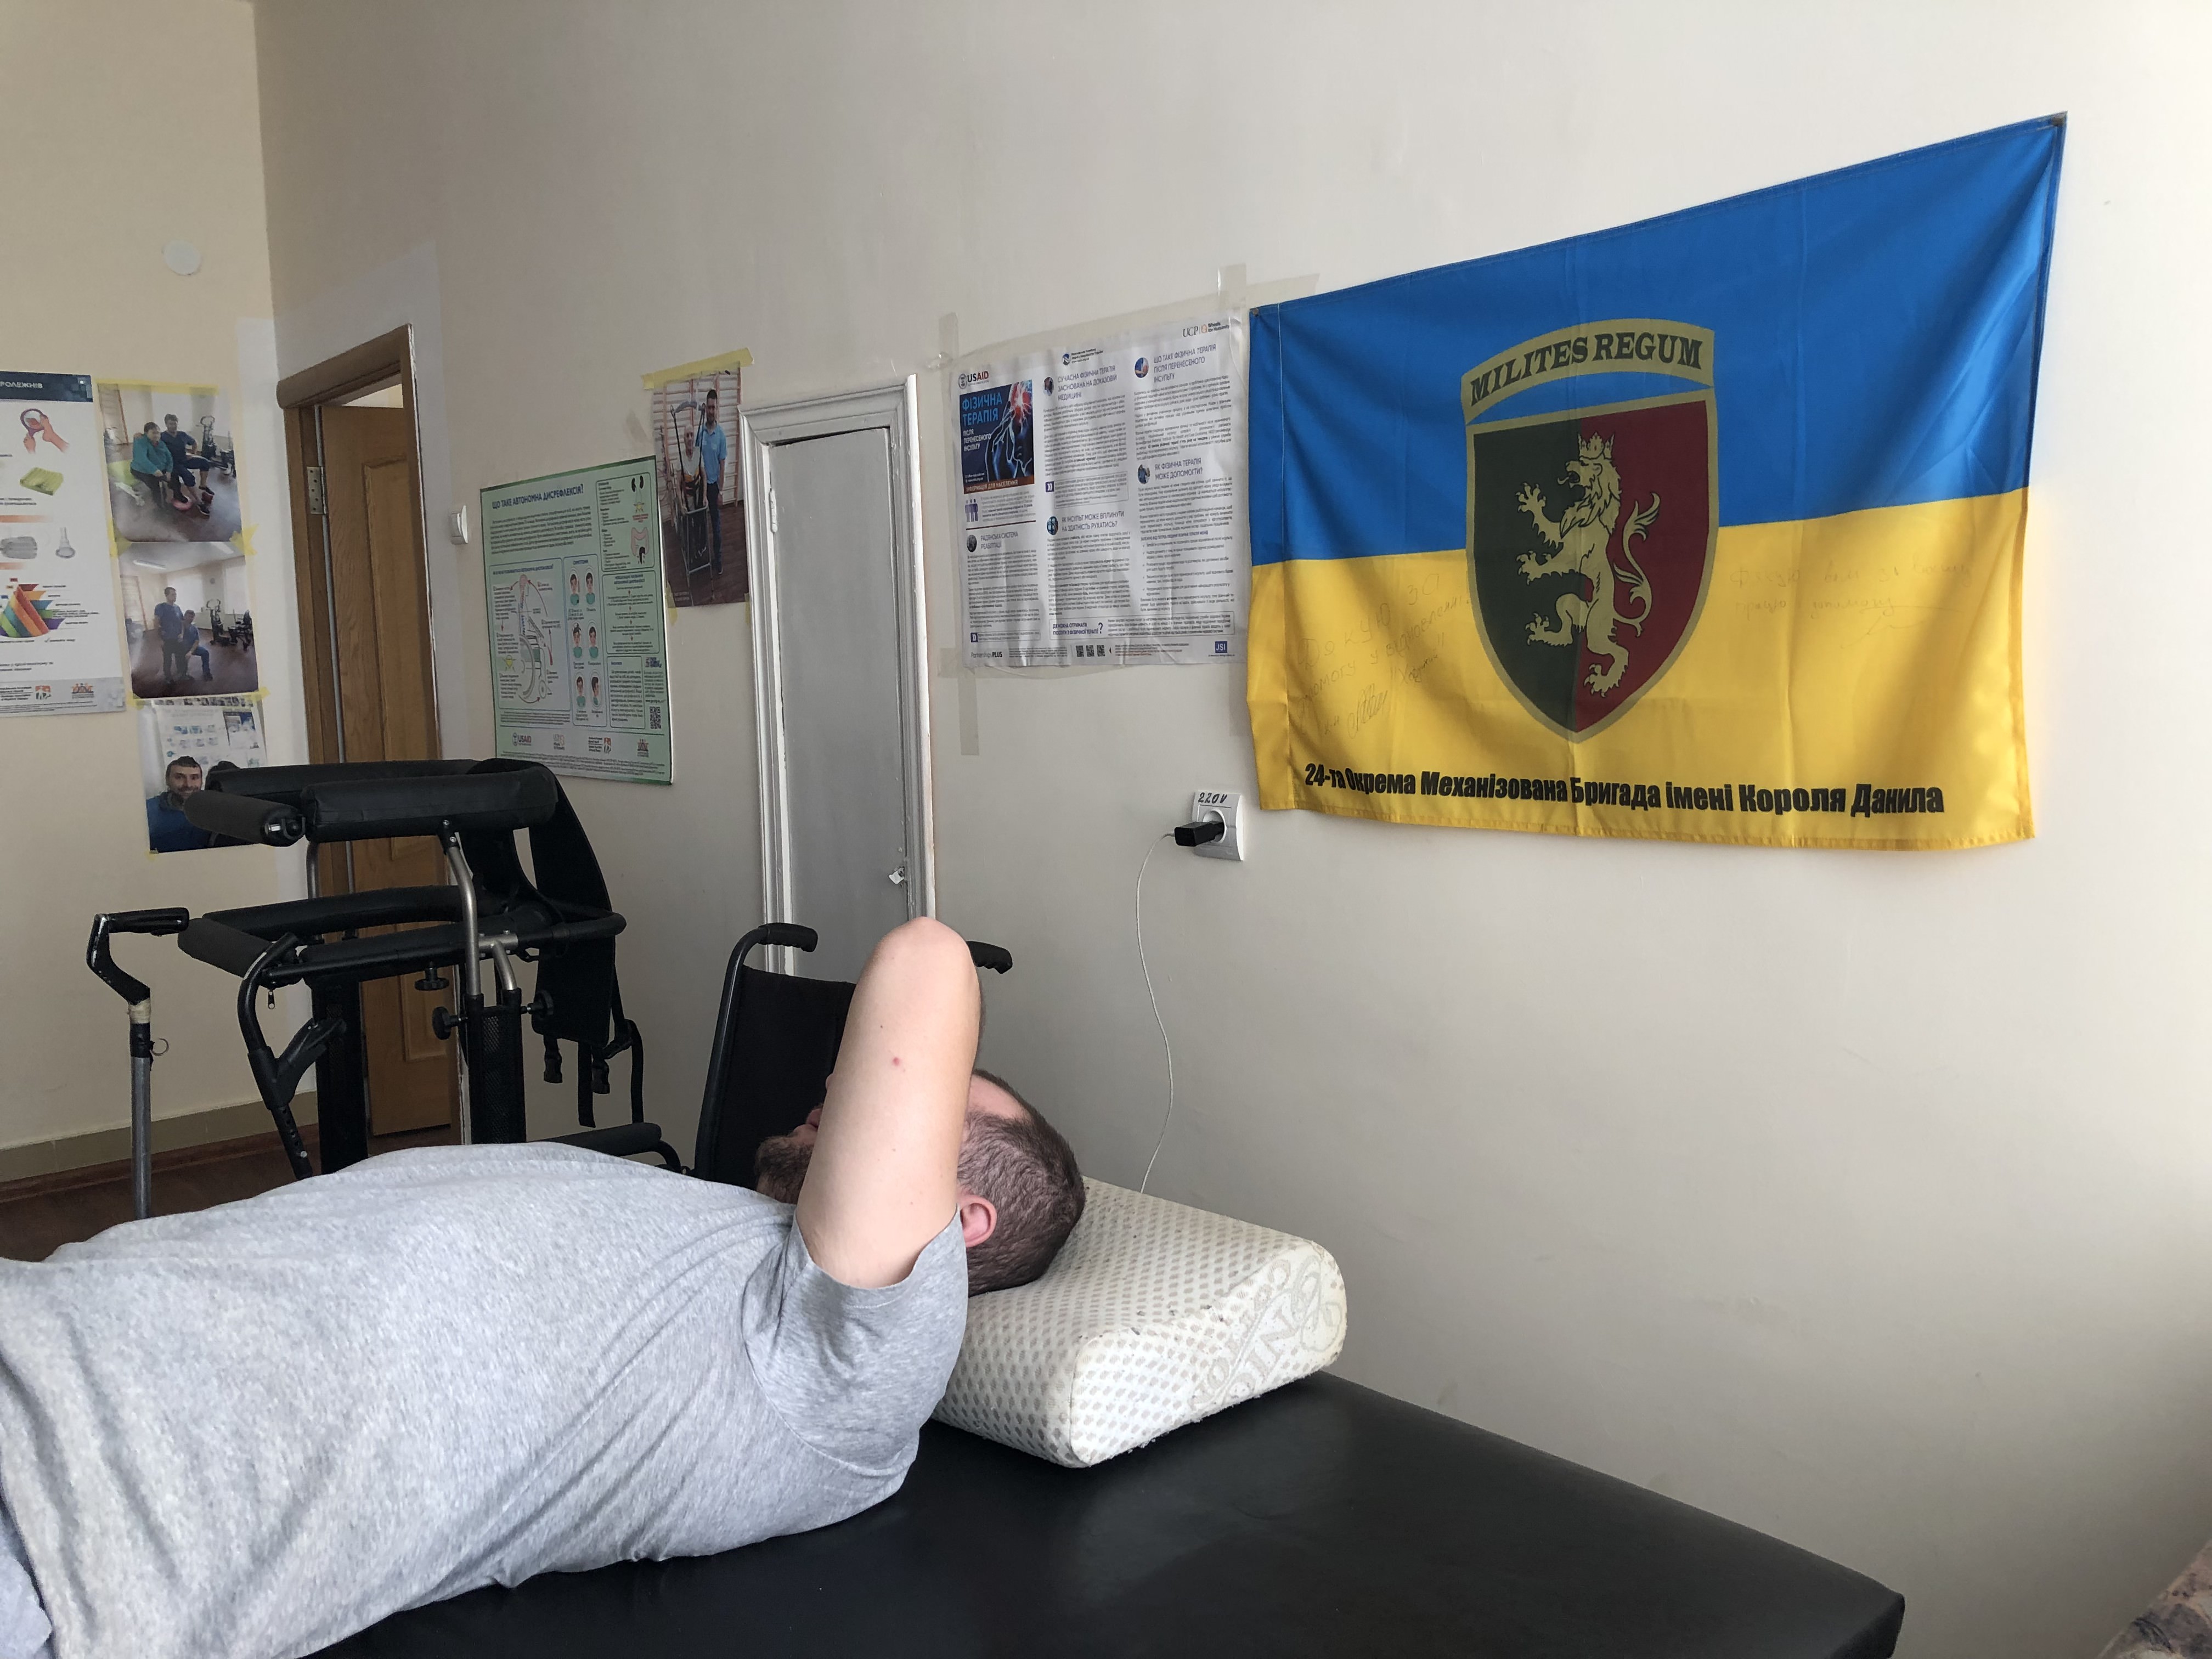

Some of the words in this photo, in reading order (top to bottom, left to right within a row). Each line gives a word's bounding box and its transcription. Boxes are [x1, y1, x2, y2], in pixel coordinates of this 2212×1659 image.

[1183, 326, 1198, 337] UCP
[1163, 353, 1173, 362] ТАКЕ
[1174, 349, 1195, 358] ФІЗИЧНА
[1197, 344, 1216, 354] ТЕРАПІЯ
[1154, 364, 1167, 373] ПІСЛЯ
[1168, 357, 1205, 370] ПЕРЕНЕСЕНОГО
[1470, 336, 1588, 407] MILITES
[1591, 332, 1702, 370] REGUM
[967, 371, 989, 382] USAID
[1058, 373, 1079, 383] СУЧАСНА
[1099, 365, 1116, 374] ТЕРАПІЯ
[1154, 373, 1175, 383] ІНСУЛЬТУ
[1058, 382, 1086, 392] ЗАСНОВАНА
[962, 392, 1002, 410] ФІЗИЧНА
[1058, 392, 1081, 400] МЕДИЦИНІ
[963, 408, 998, 426] ТЕРАПІЯ
[964, 433, 991, 444] ПЕРЕНЕСЕНОГО
[1161, 461, 1182, 469] ФІЗИЧНА
[1183, 458, 1201, 466] ТЕРАПІЯ
[1155, 471, 1169, 479] МОЖЕ
[1170, 467, 1203, 478] ДОПОМОГТИ?
[492, 501, 500, 509] ЩО
[501, 499, 512, 507] ТАКЕ
[513, 494, 542, 505] АВТОНОМНА
[543, 483, 583, 501] ДИСРЕФЛЕКСІЯ?
[1100, 511, 1124, 520] ВПЛИНУТИ
[1068, 523, 1090, 532] ЗДАТНІСТЬ
[1091, 521, 1118, 529] РУХАТИСЬ?
[1305, 763, 1346, 789] 24-та
[1346, 768, 1415, 794] Окрема
[1421, 771, 1567, 803] Механізована
[1570, 777, 1661, 810] Бригада
[1666, 782, 1734, 811] імені
[1738, 783, 1847, 815] Короля
[1850, 783, 1944, 817] Данила
[1198, 792, 1228, 804] 220V
